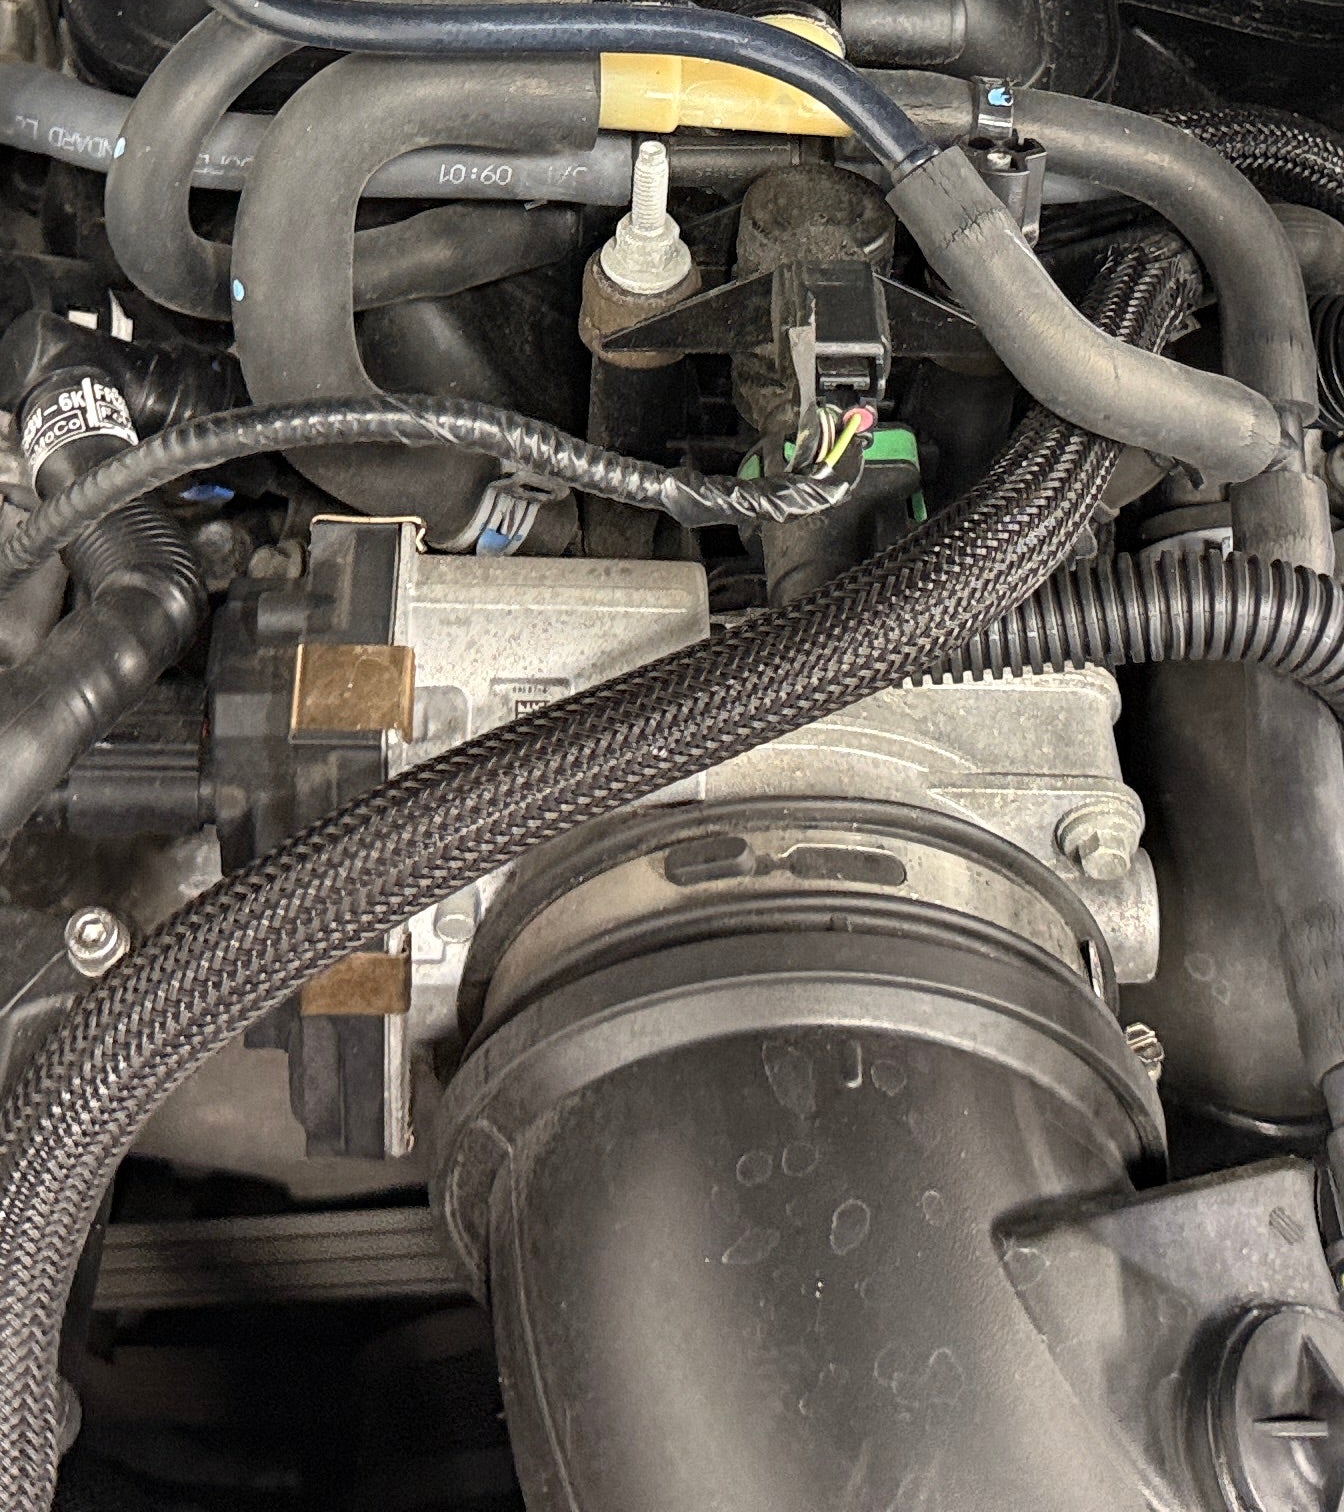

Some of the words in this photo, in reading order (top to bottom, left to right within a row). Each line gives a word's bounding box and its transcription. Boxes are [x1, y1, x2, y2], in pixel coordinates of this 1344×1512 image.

[47, 125, 117, 159] NDARD
[439, 164, 513, 187] 09:01
[29, 416, 82, 467] oMoCo
